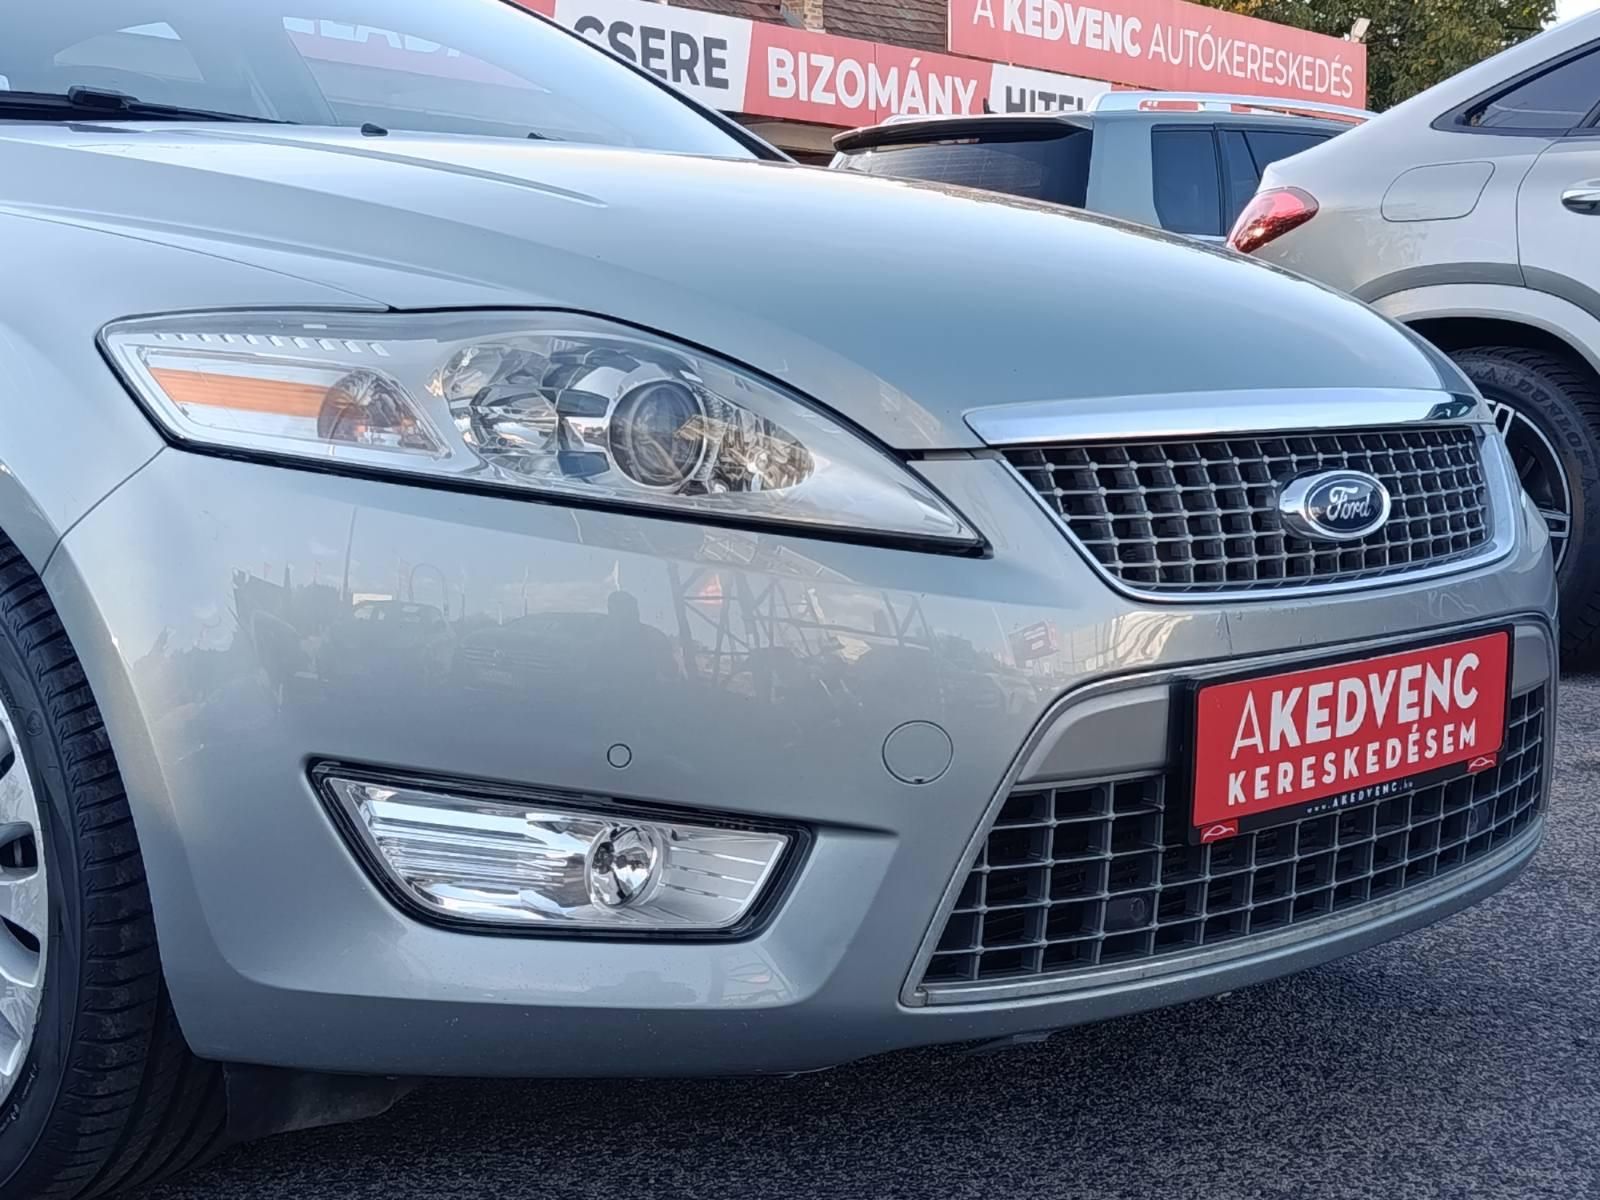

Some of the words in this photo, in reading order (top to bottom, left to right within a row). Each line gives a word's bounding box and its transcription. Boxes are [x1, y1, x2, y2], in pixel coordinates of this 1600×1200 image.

[767, 47, 978, 115] BIZOMÁNY
[1003, 0, 1142, 57] KEDVENC
[1148, 27, 1353, 98] AUTÓKERESKEDÉS
[1326, 487, 1371, 521] Ford
[1227, 718, 1476, 806] KERESKEDÉSEM
